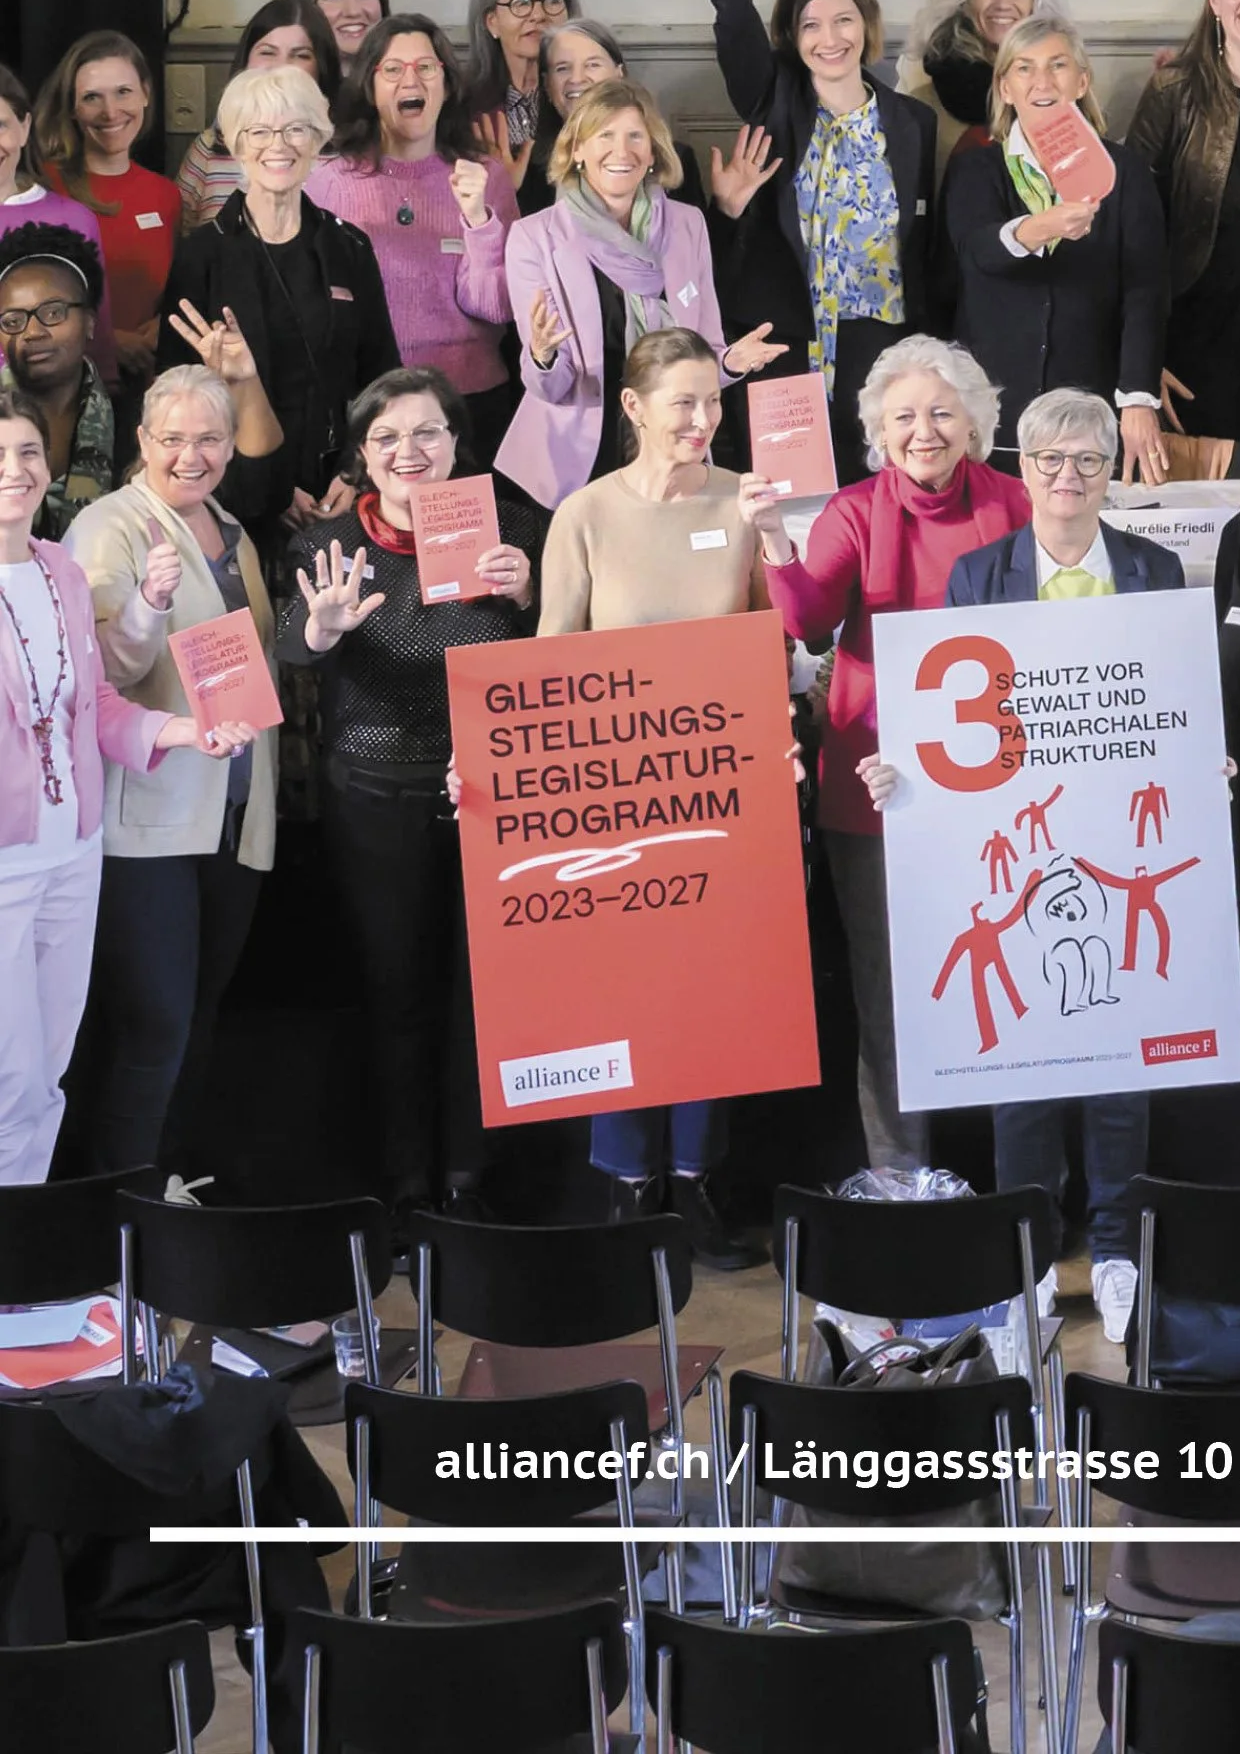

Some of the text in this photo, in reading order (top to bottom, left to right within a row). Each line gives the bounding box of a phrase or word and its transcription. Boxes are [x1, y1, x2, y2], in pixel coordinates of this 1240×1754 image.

[1125, 521, 1215, 535] Aurélie Friedli
[485, 669, 653, 714] GLEICH-
[996, 661, 1144, 691] SCHUTZ VOR
[915, 635, 1027, 793] 3
[997, 688, 1146, 716] GEWALT UND
[489, 702, 744, 758] STELLUNGS-
[1000, 710, 1188, 744] PATRIARCHALEN
[1001, 739, 1156, 769] STRUKTUREN
[493, 744, 754, 802] LEGISLATUR-
[496, 787, 740, 845] PROGRAMM
[1149, 1038, 1211, 1057] alliance F
[515, 1058, 619, 1091] alliance F
